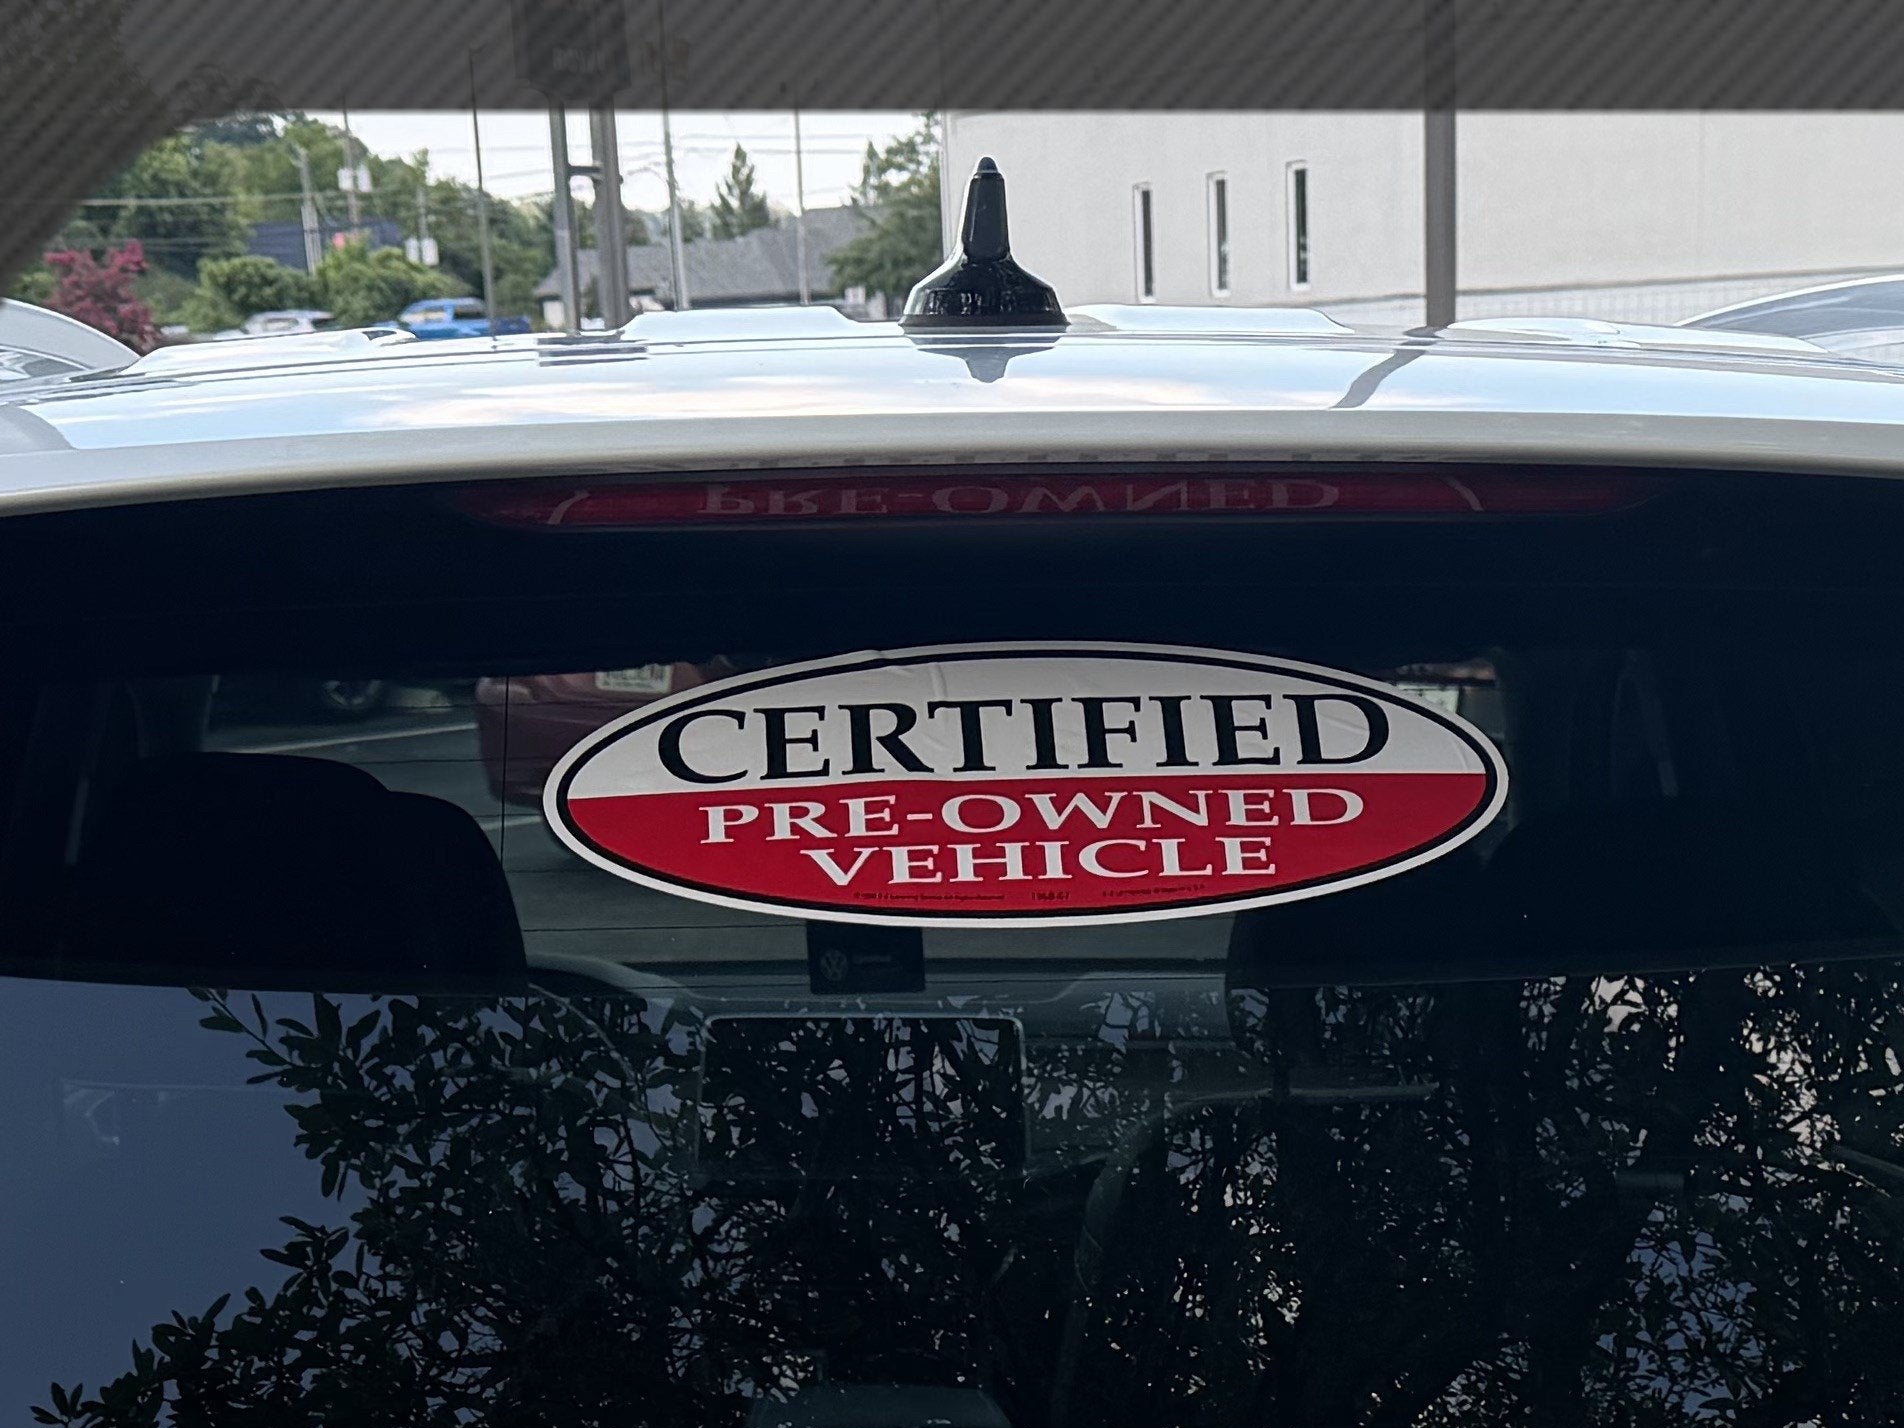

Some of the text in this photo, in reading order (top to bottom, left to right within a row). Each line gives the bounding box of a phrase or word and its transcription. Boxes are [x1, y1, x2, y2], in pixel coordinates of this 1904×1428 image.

[657, 693, 1390, 786] CERTIFIED
[699, 787, 1364, 844] PRE-OWNED
[801, 837, 1277, 887] VEHICLE
